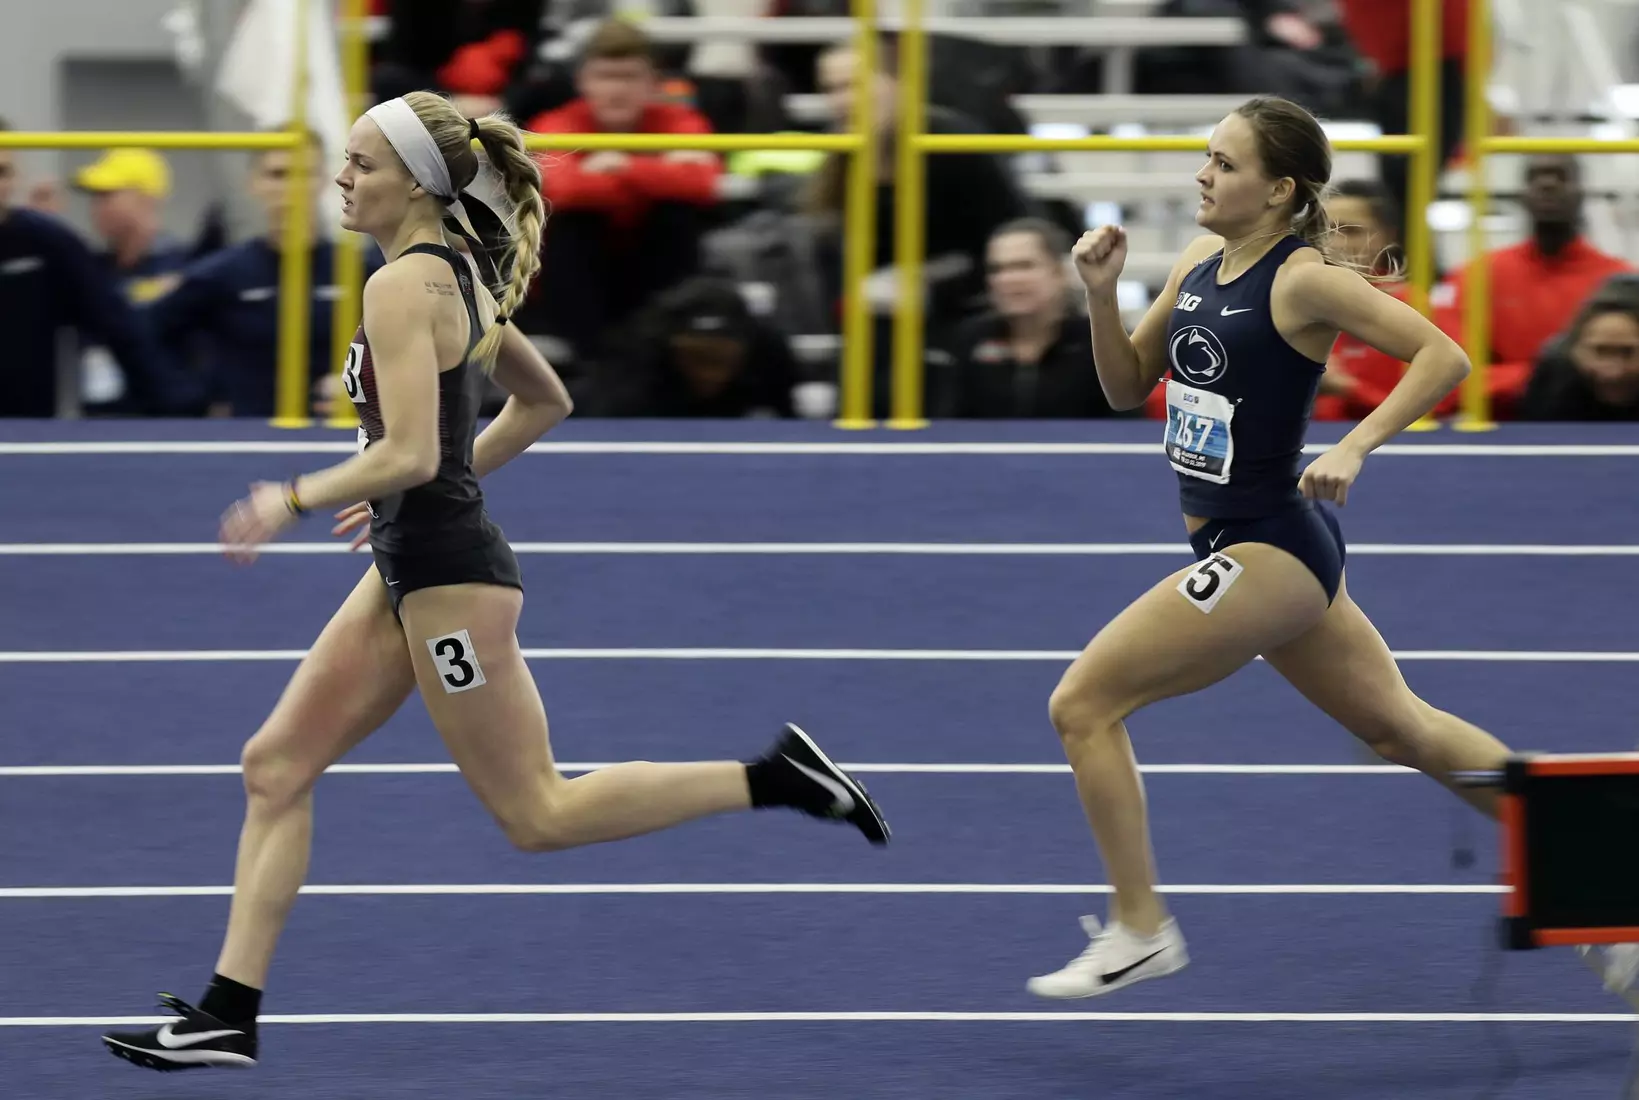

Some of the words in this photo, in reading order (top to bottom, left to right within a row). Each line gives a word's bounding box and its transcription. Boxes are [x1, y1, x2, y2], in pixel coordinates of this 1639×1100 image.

[1175, 411, 1214, 452] 267
[1186, 554, 1234, 602] 5
[434, 637, 475, 688] 3
